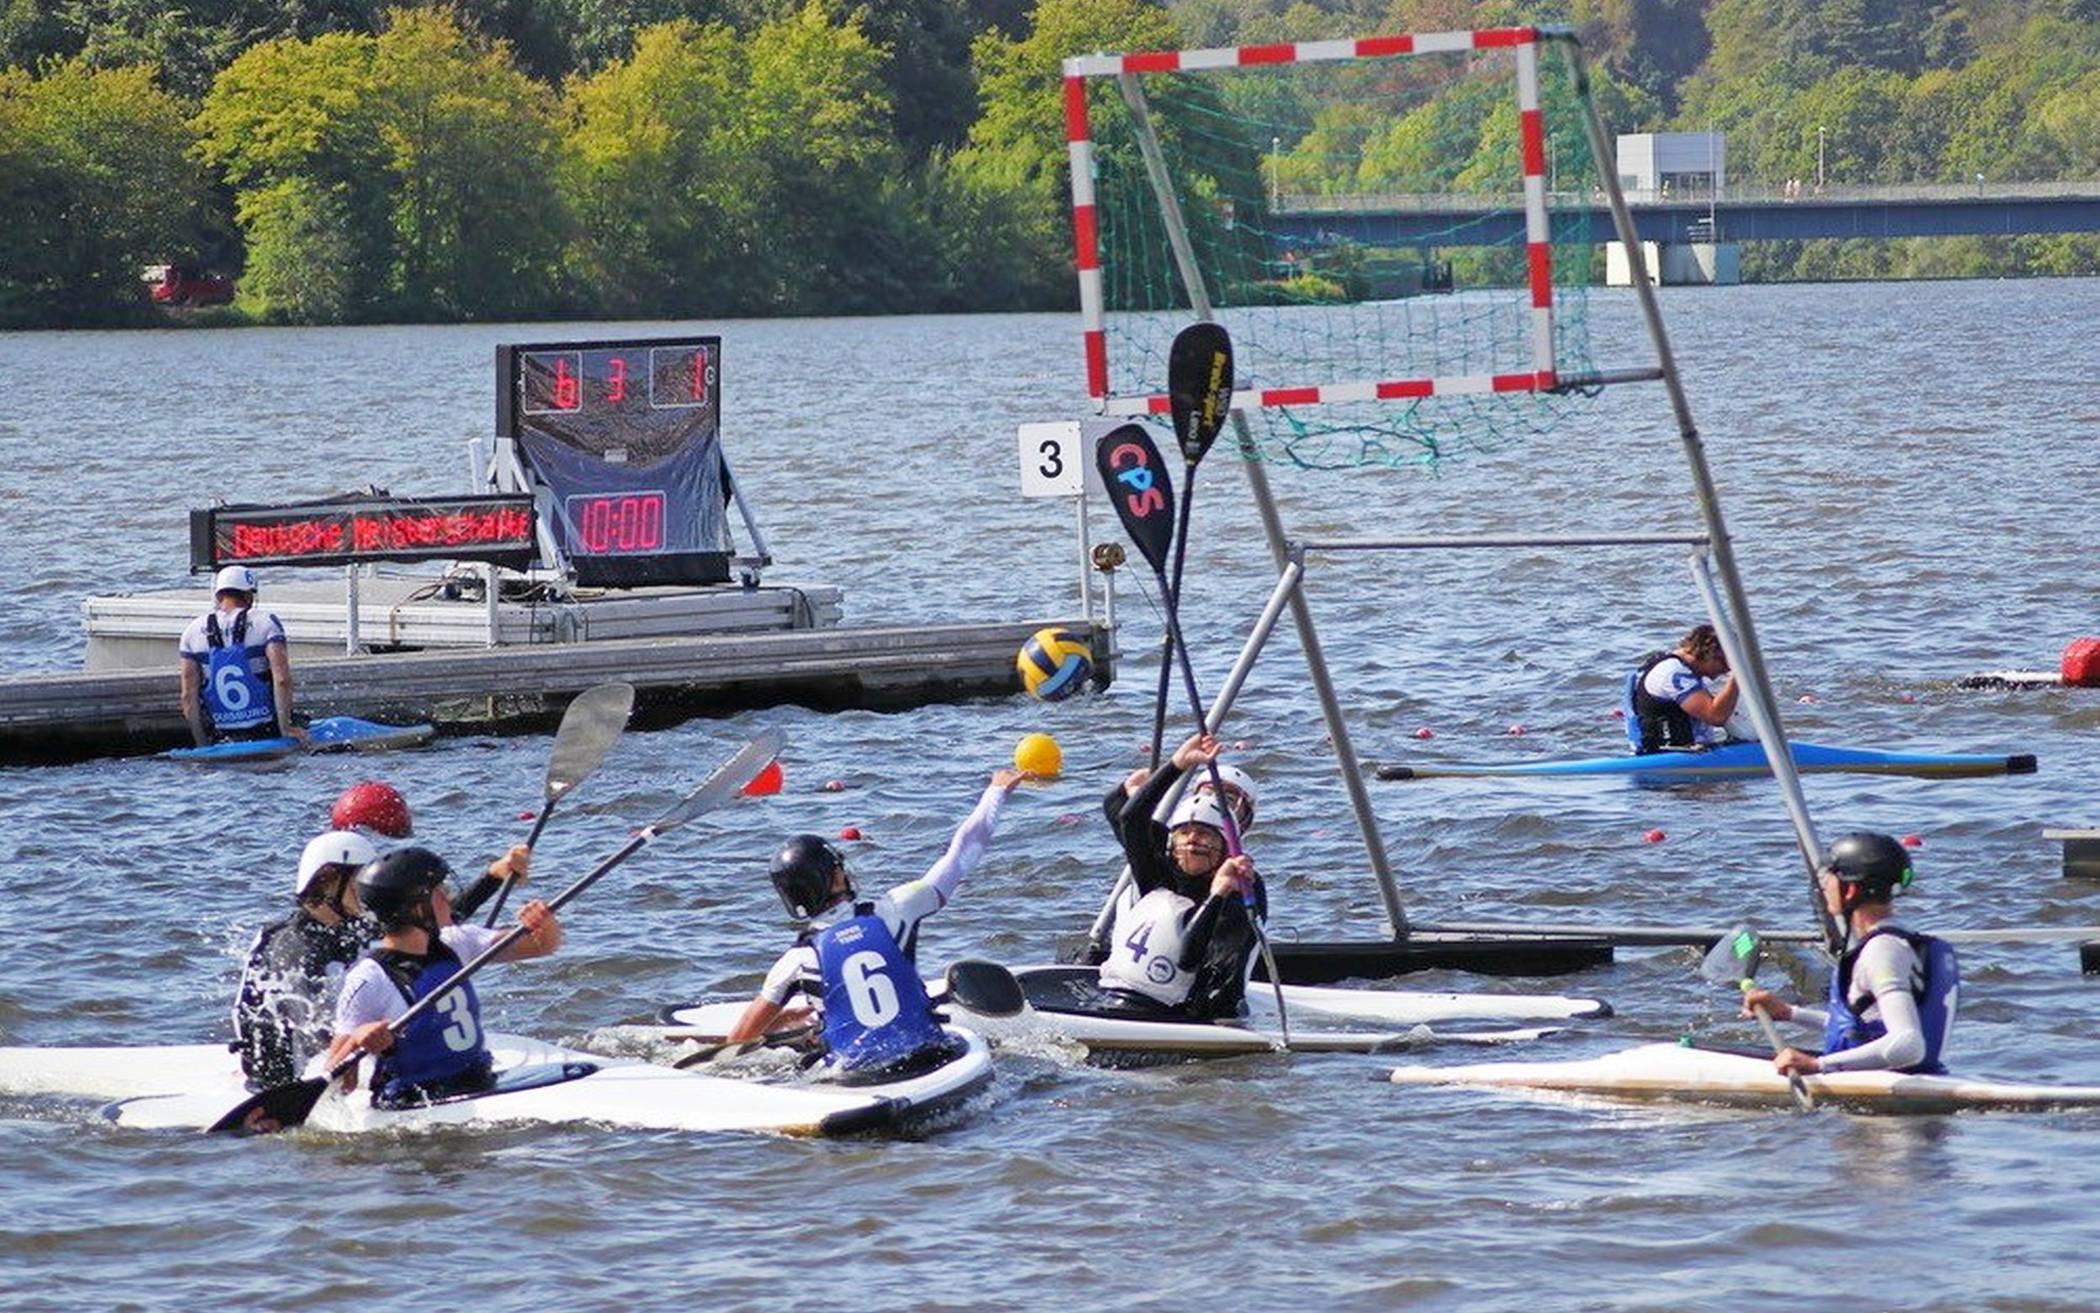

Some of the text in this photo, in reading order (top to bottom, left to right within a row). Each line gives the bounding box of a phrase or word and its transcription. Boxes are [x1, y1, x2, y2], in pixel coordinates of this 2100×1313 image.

[608, 358, 625, 403] 3
[692, 352, 705, 400] 1
[1040, 440, 1063, 479] 3
[1110, 443, 1165, 519] CPS
[233, 519, 343, 558] Deutsche
[583, 496, 660, 552] 10:00
[215, 664, 250, 711] 6
[1125, 920, 1153, 964] 4
[841, 950, 900, 1029] 6
[436, 984, 478, 1052] 3
